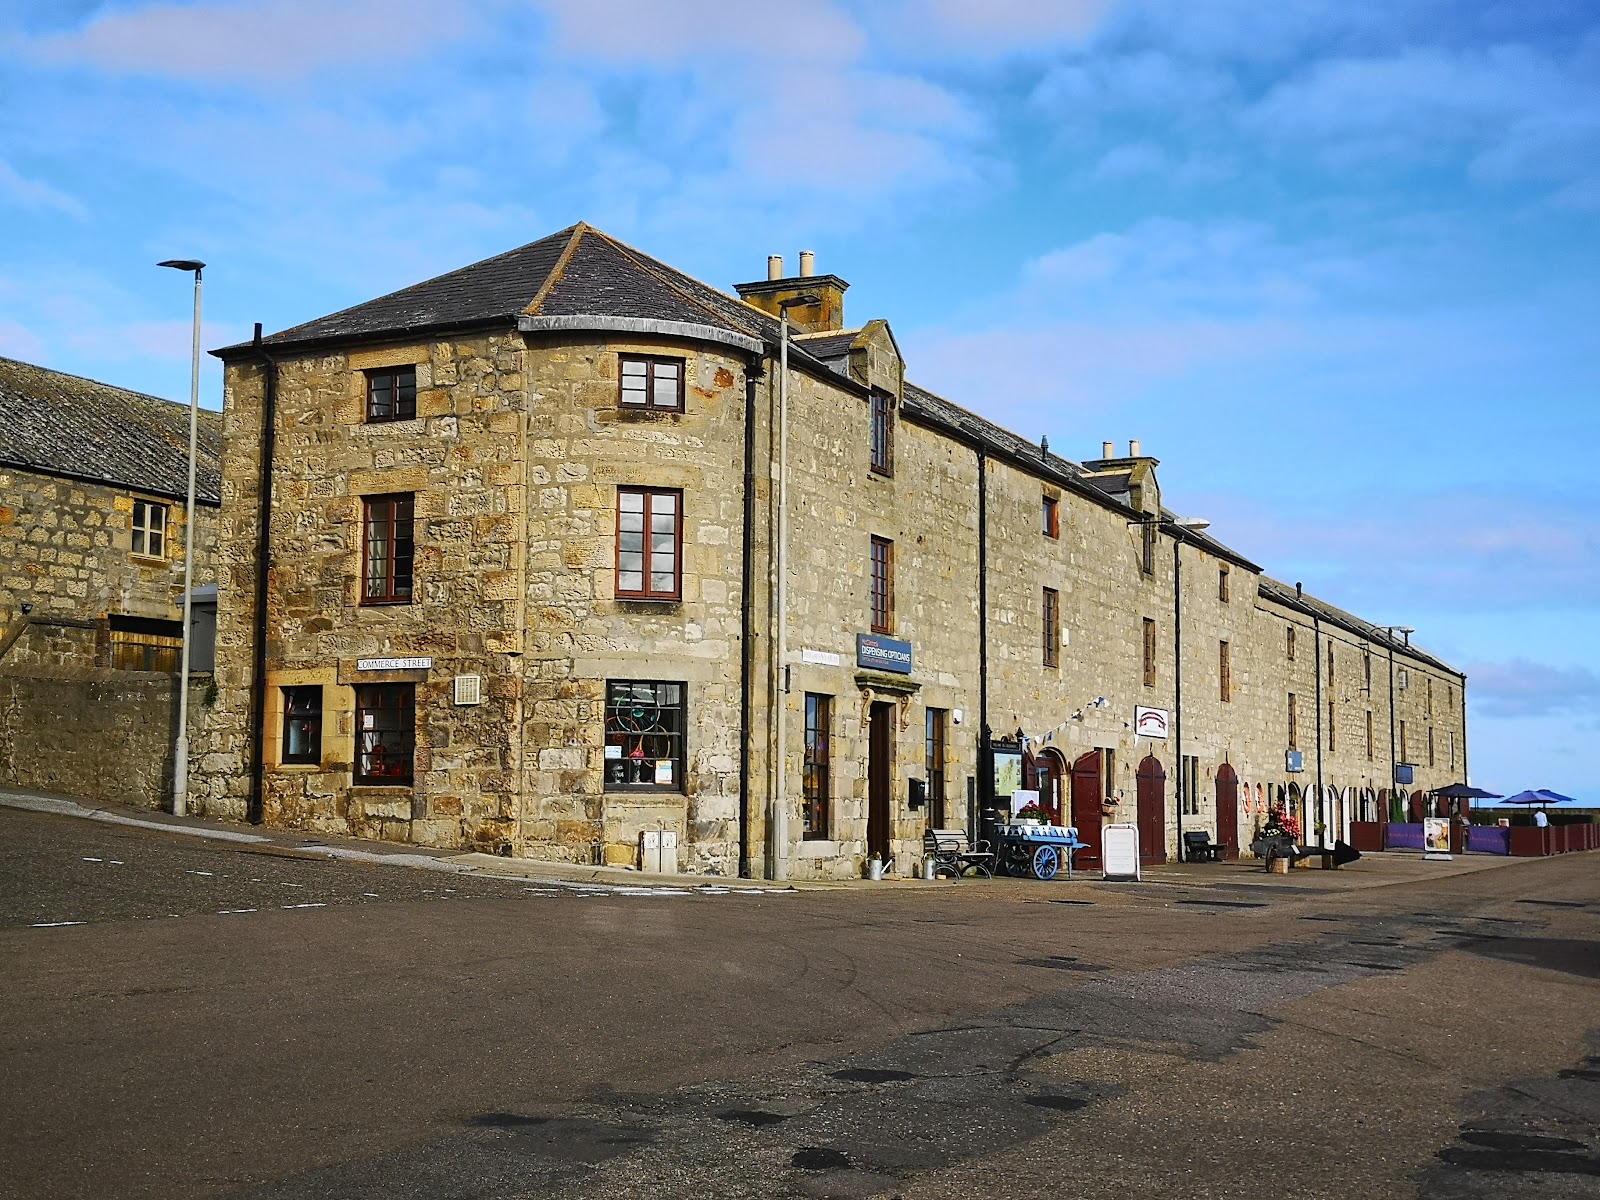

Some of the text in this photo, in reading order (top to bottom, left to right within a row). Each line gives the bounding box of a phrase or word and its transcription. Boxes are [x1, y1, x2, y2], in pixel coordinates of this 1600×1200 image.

[862, 645, 888, 659] DISPENSING
[888, 650, 910, 662] OPTICIANS
[358, 659, 431, 669] COMMERCE STREET
